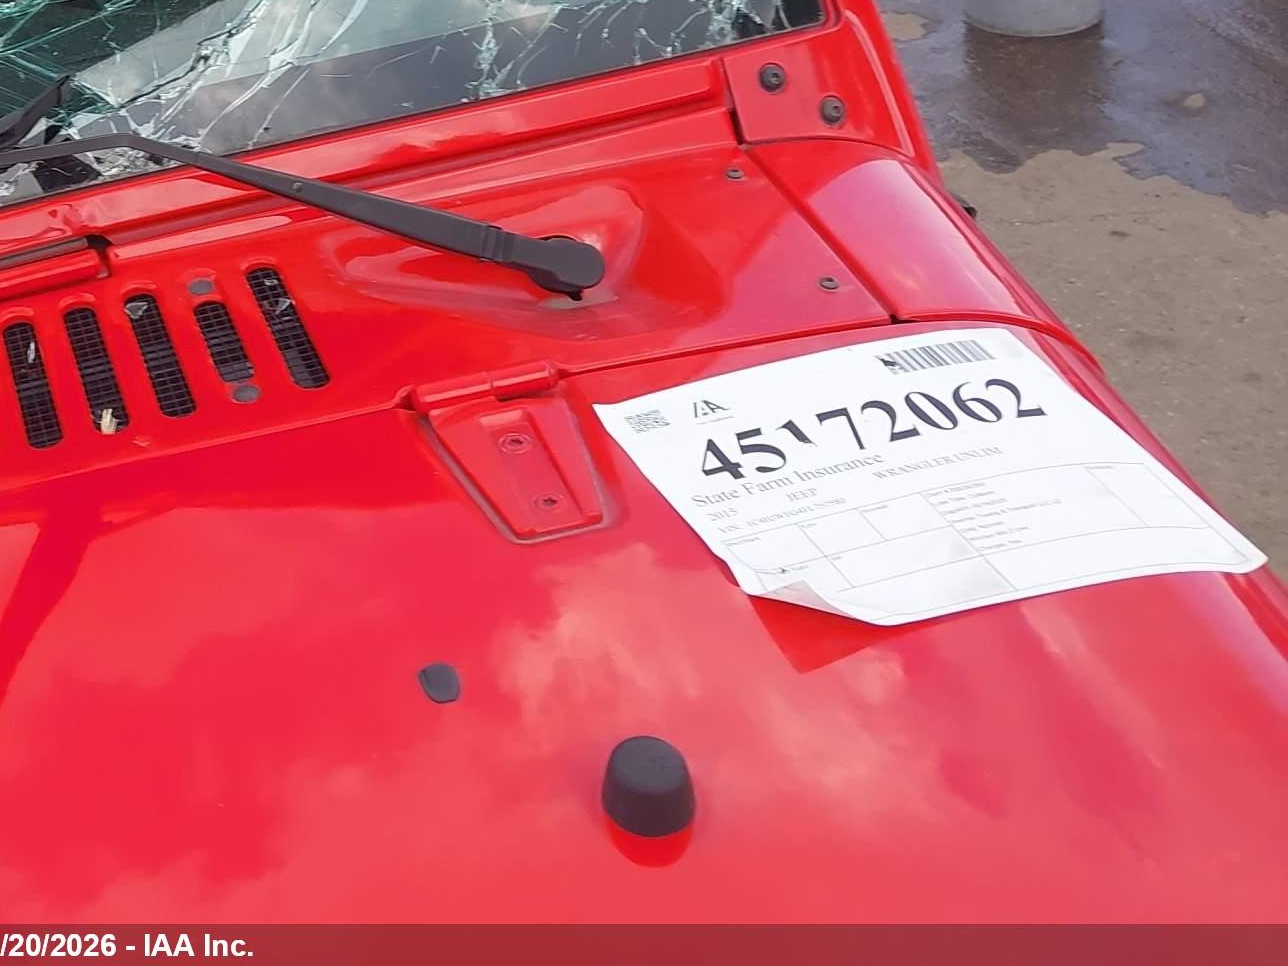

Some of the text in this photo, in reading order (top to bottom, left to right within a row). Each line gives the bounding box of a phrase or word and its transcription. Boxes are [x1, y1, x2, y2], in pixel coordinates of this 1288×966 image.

[701, 378, 1048, 480] 45172062
[690, 451, 884, 509] State Farm Insurance
[786, 487, 817, 502] JEEP
[871, 455, 954, 480] WRANGLER
